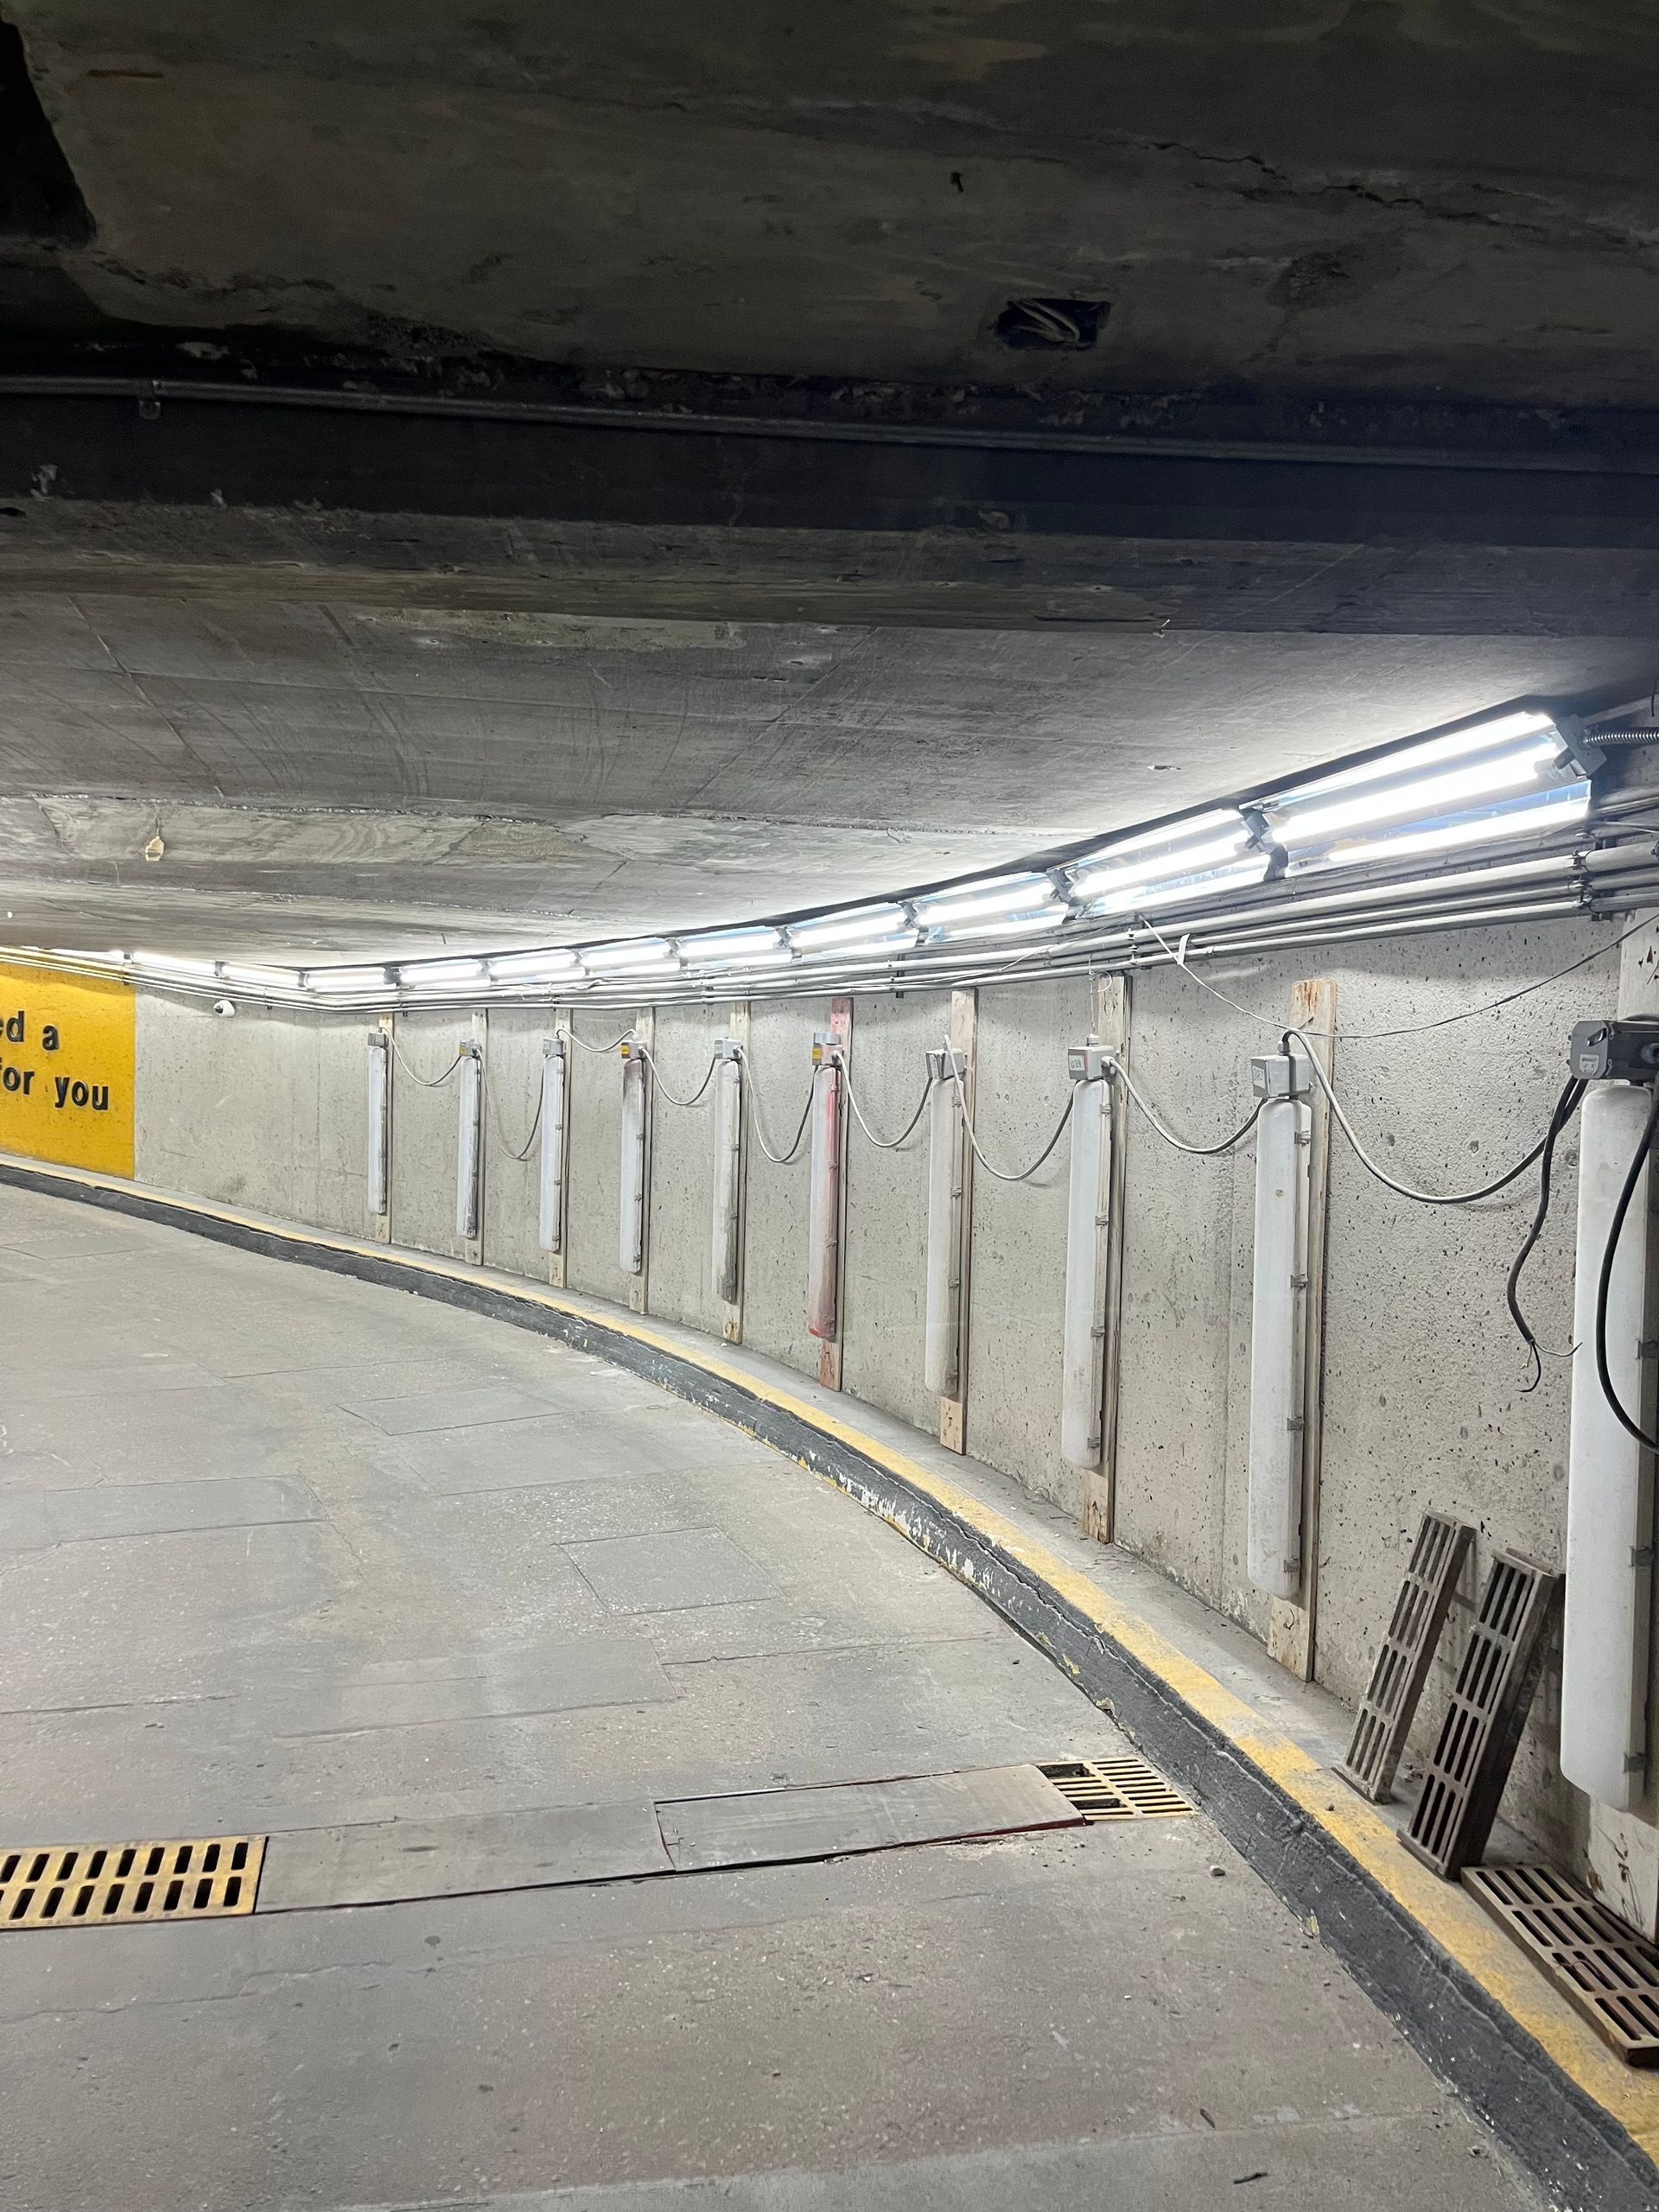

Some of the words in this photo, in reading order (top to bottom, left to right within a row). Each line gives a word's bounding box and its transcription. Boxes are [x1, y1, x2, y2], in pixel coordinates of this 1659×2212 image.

[0, 1010, 24, 1042] d
[42, 1025, 60, 1051] a
[0, 1057, 35, 1096] or
[54, 1077, 109, 1110] you
